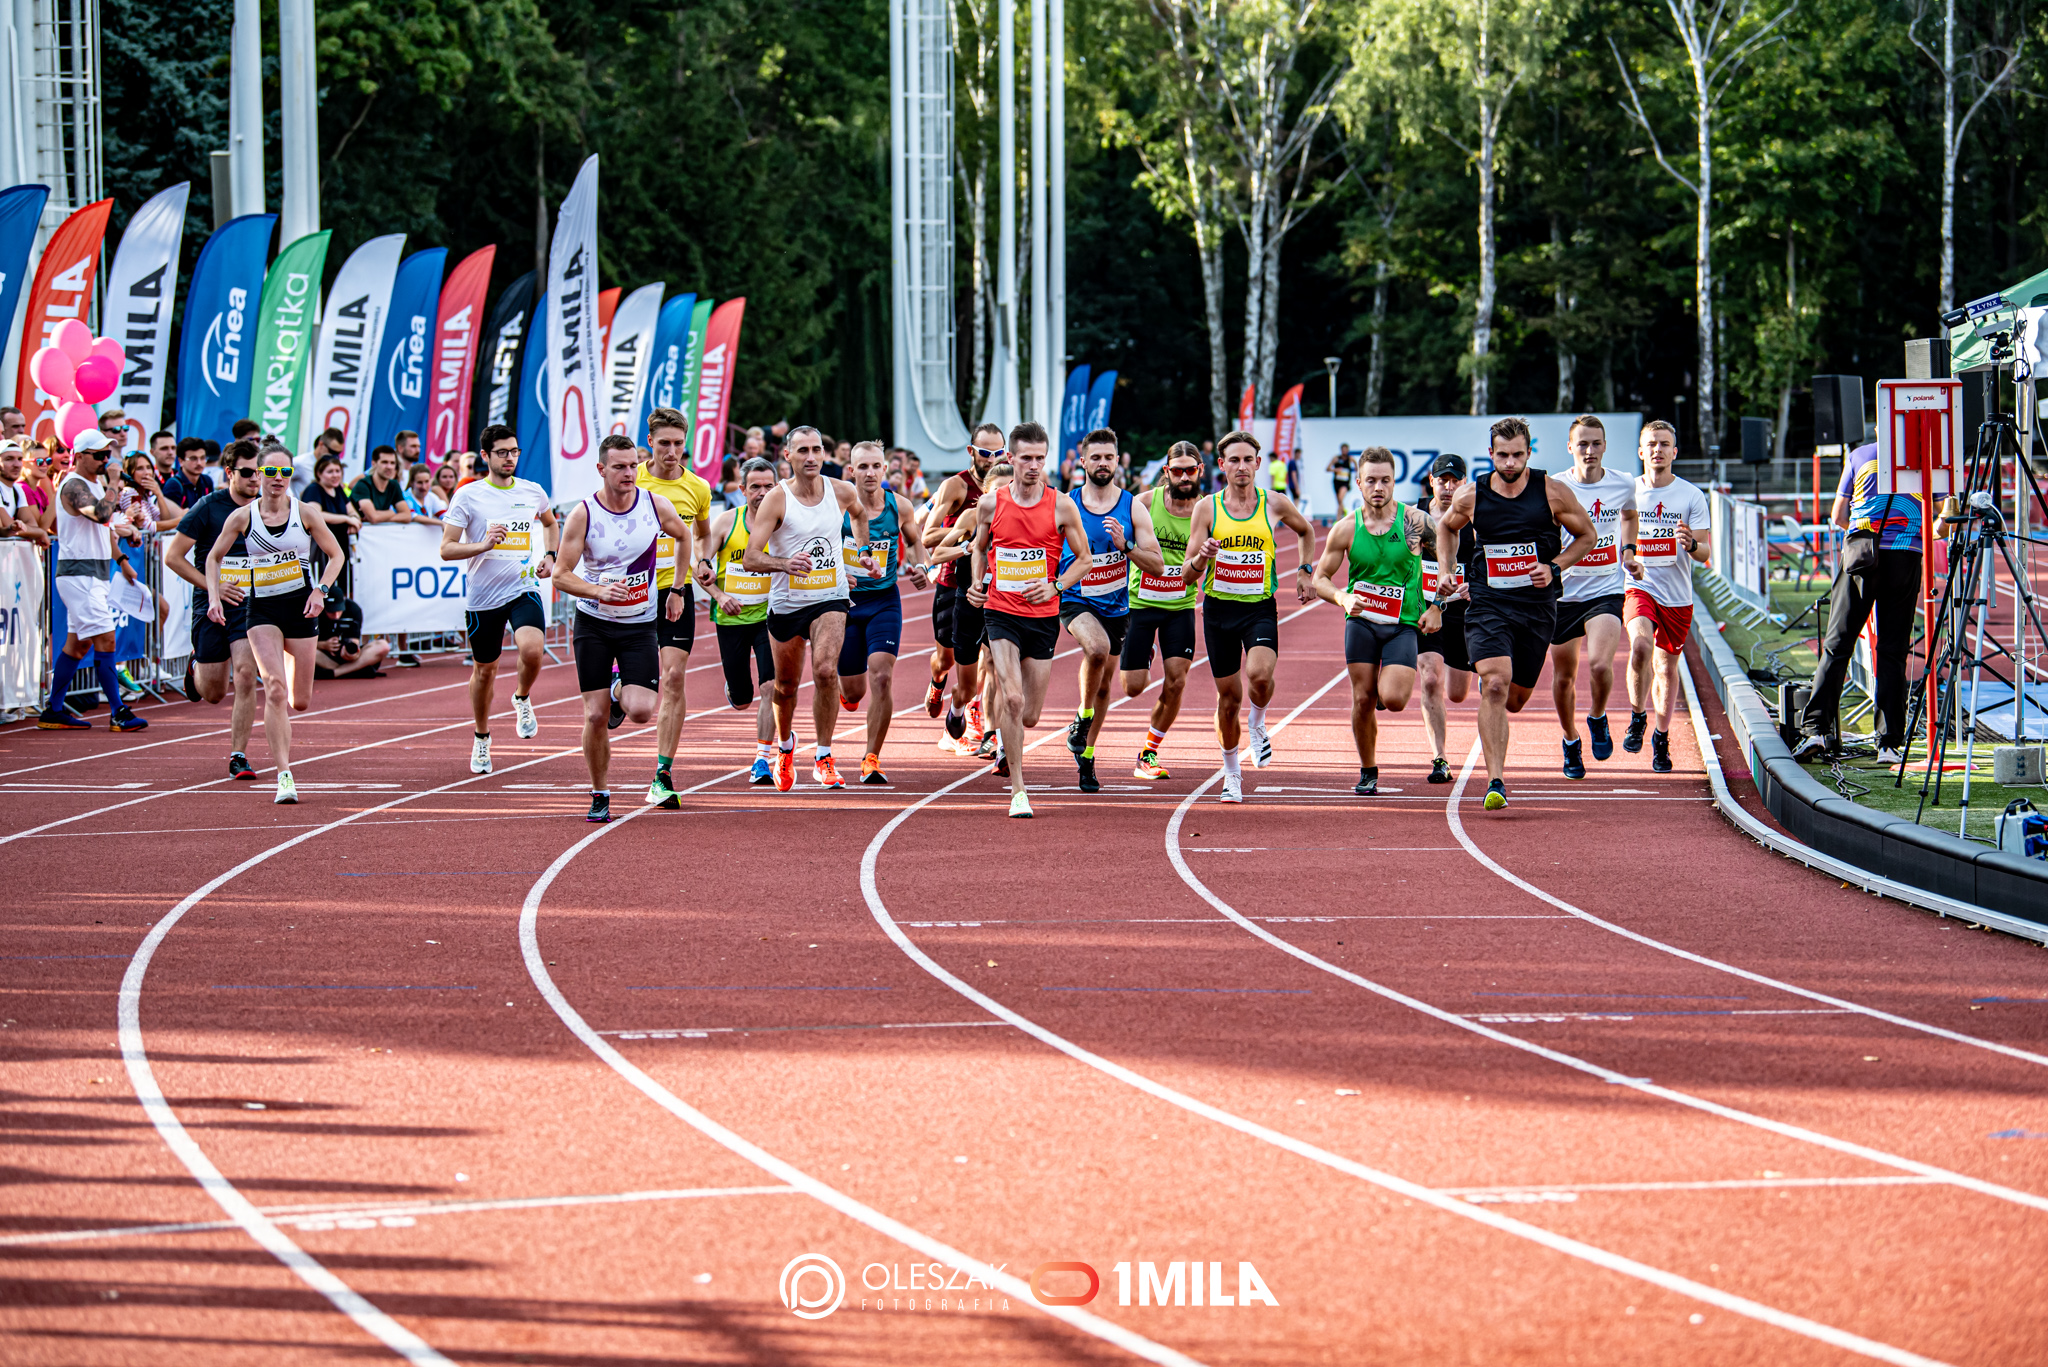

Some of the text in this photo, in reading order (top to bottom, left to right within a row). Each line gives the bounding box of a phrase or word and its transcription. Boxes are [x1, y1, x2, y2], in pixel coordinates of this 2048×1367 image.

[561, 242, 586, 379] 1MILA
[1977, 299, 1998, 311] LYNX
[120, 262, 168, 407] 1MILA
[216, 287, 247, 383] Enea
[328, 294, 370, 400] 1MILA
[402, 315, 427, 398] Enea
[438, 304, 472, 405] 1MILA
[611, 333, 638, 416] 1MILA
[659, 345, 679, 408] Enea
[698, 343, 727, 421] 1MILA
[1913, 395, 1935, 403] polanik
[511, 521, 530, 531] 249
[1653, 528, 1674, 538] 228
[869, 542, 888, 550] 243
[1597, 535, 1614, 548] 229
[1020, 549, 1044, 561] 239
[1511, 544, 1534, 556] 230
[273, 551, 296, 564] 248
[816, 557, 835, 569] 246
[1105, 553, 1125, 564] 236
[1241, 554, 1262, 564] 235
[1583, 553, 1609, 562] POCZTA
[255, 565, 300, 581] JARASZKIEWICZ
[1000, 565, 1044, 576] SZATKOWSKI
[1167, 567, 1182, 576] 23
[1217, 567, 1262, 578] SKOWROŃSKI
[627, 572, 646, 586] 251
[794, 572, 833, 584] KRZYSZTOŃ
[735, 581, 761, 590] JAGIEŁA
[1379, 586, 1402, 598] 233
